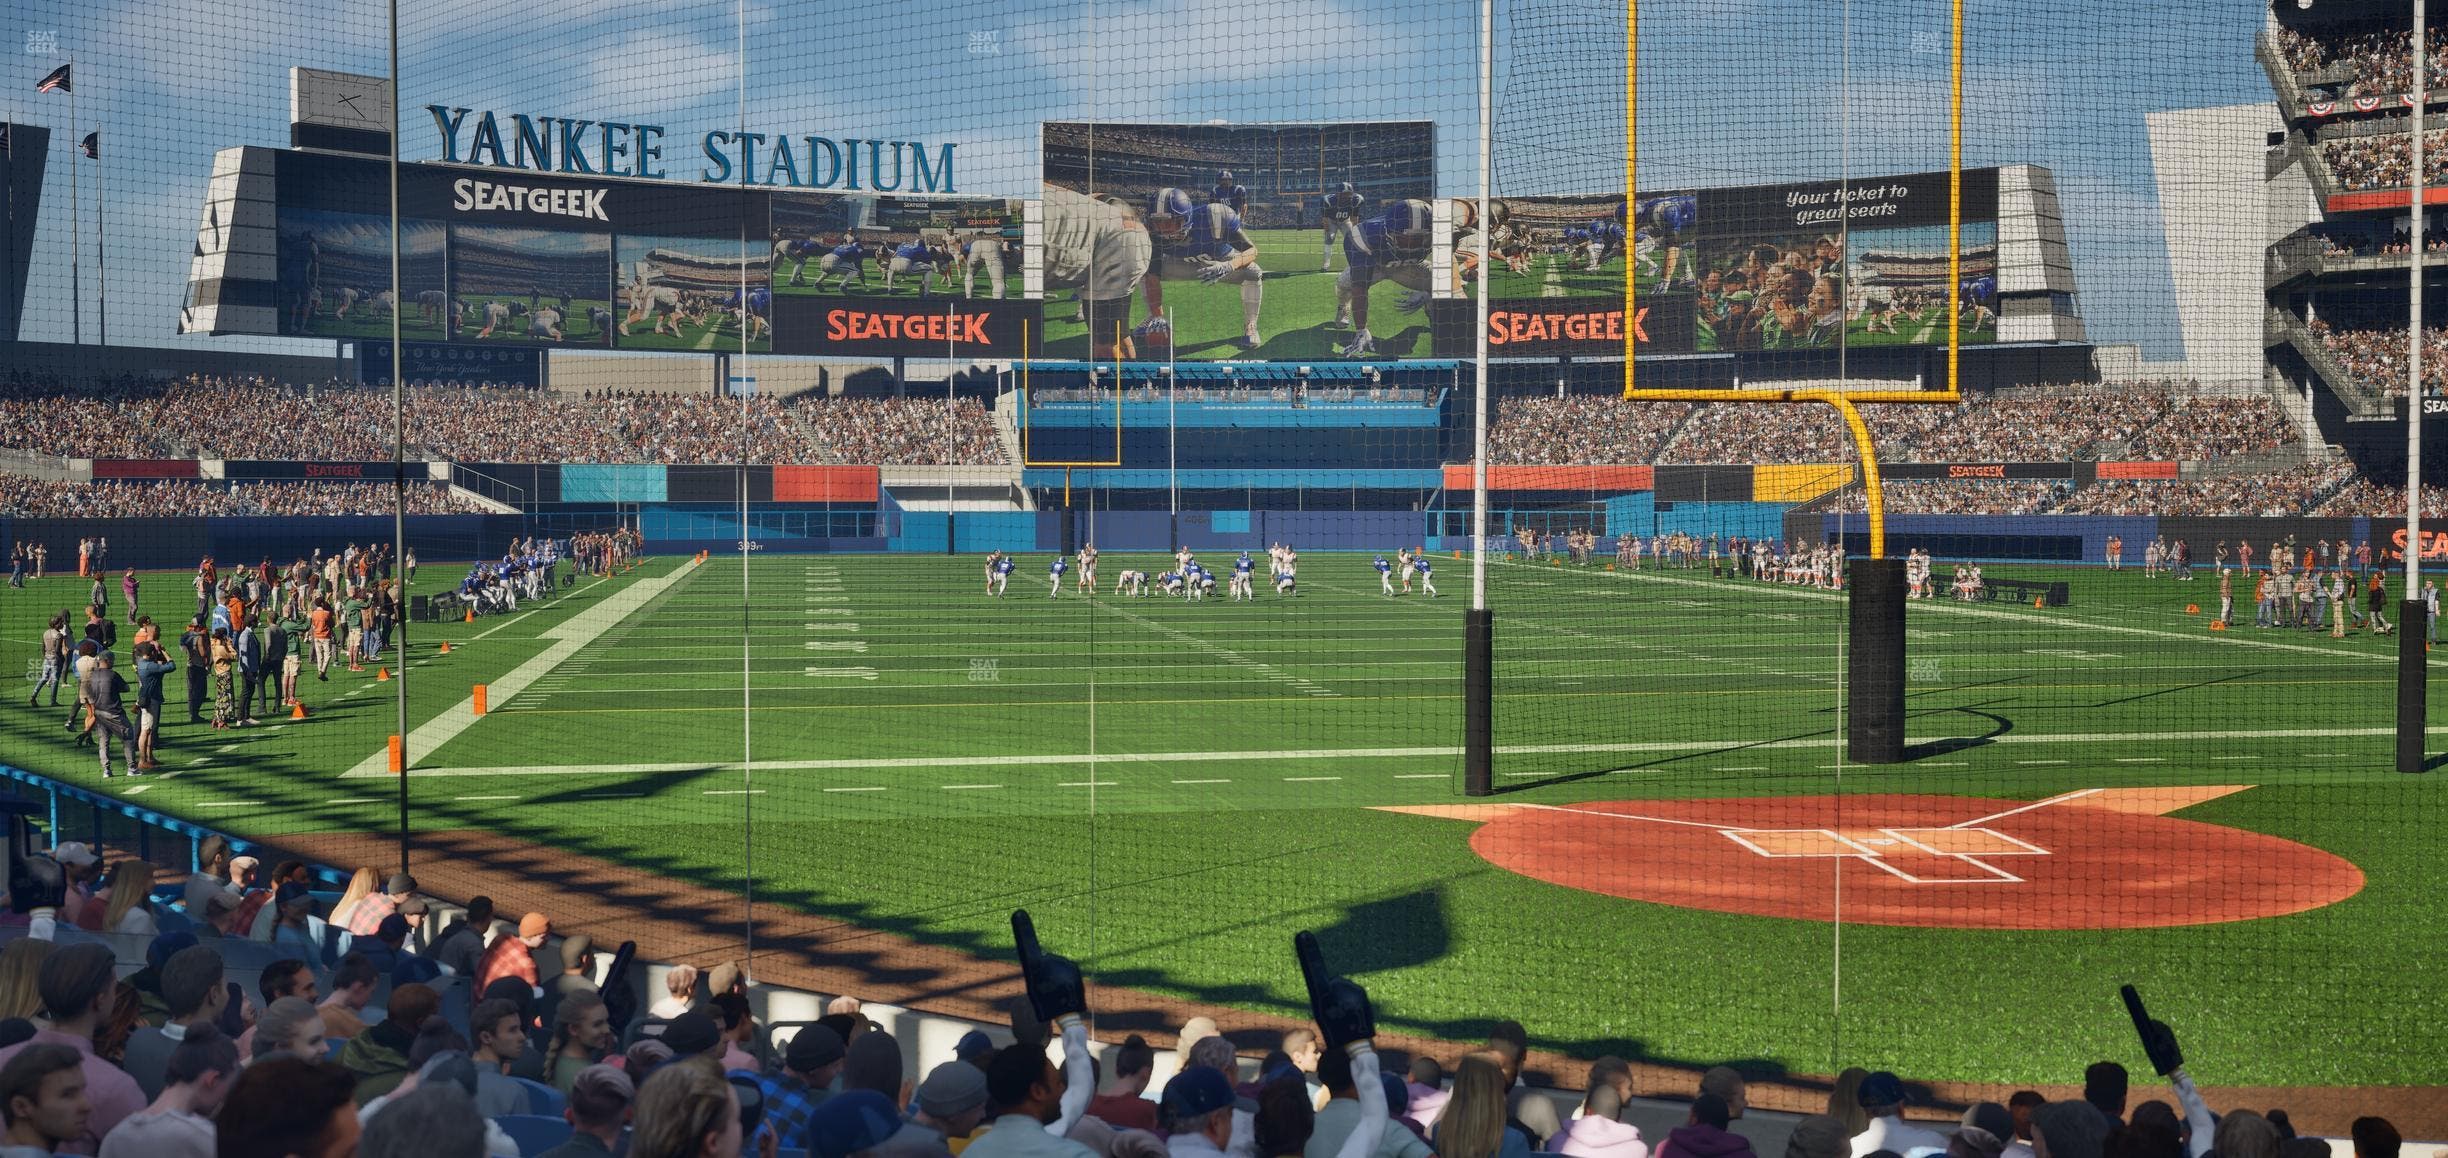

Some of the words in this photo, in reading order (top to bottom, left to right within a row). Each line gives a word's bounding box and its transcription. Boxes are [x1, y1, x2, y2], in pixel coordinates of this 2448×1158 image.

[424, 104, 666, 179] YANKEE
[701, 130, 958, 194] STADIUM
[453, 178, 610, 222] SEATGEEK
[1786, 191, 1830, 208] Your
[1832, 185, 1887, 203] ticket
[1888, 184, 1908, 198] to
[1796, 204, 1847, 225] great
[1848, 202, 1897, 218] seats
[827, 309, 992, 345] SEATGEEK
[1488, 307, 1650, 345] SEATGEEK
[2423, 399, 2448, 413] SEA
[305, 463, 363, 477] SEATGEEK
[1949, 464, 2006, 478] SEATGEEK
